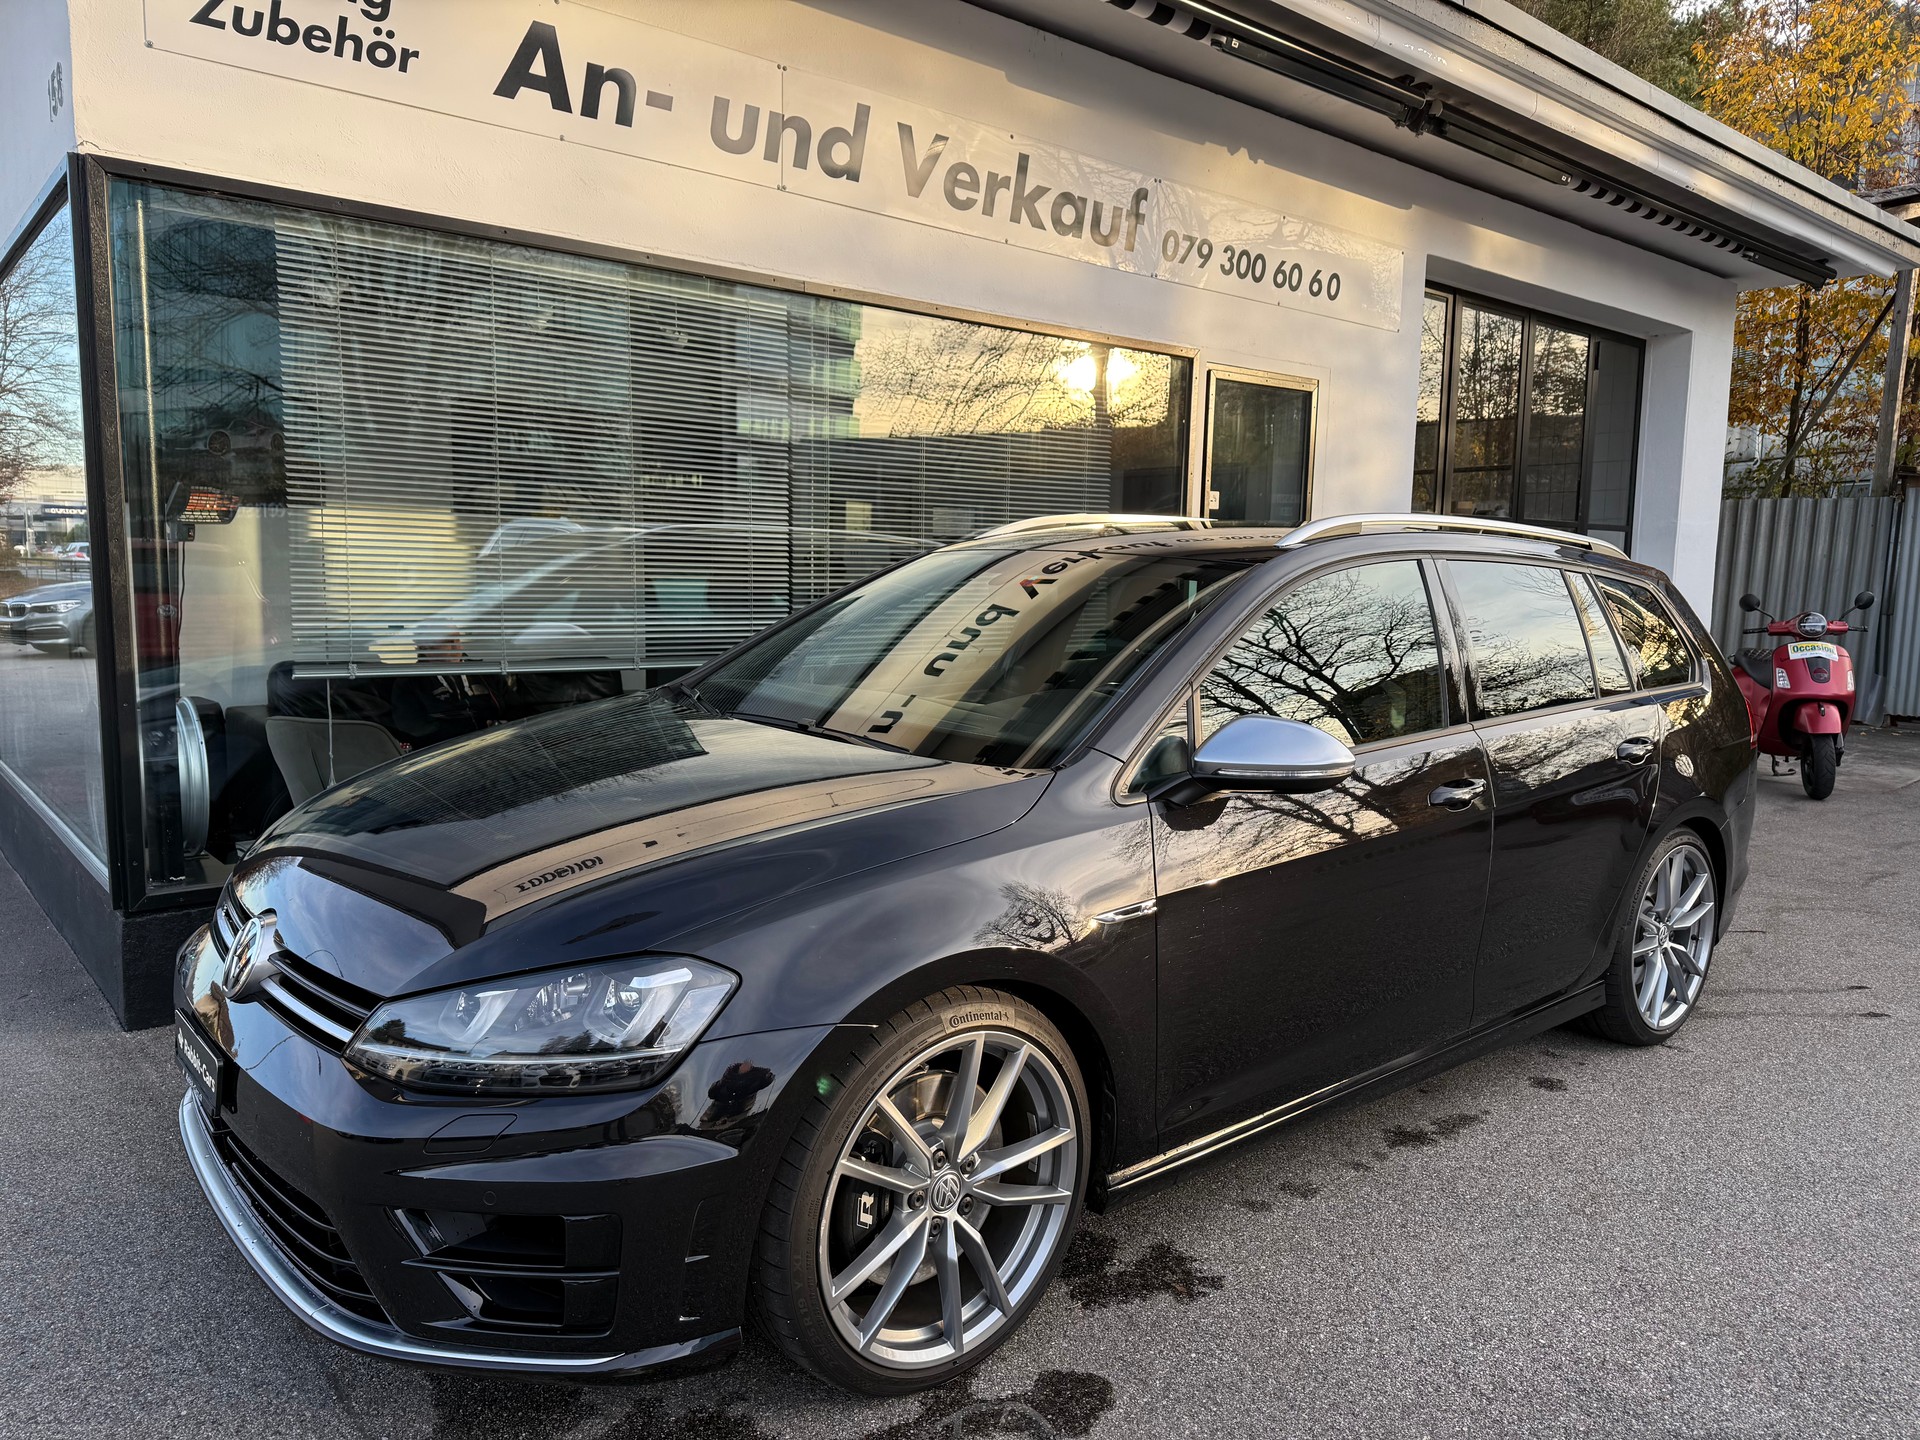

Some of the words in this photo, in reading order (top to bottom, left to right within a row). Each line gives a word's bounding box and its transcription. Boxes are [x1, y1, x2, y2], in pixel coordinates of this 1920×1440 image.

[189, 0, 420, 73] Zubehör
[493, 20, 674, 128] An-
[710, 95, 871, 183] und
[897, 121, 1149, 253] Verkauf
[1161, 229, 1213, 269] 079
[1220, 244, 1267, 283] 300
[1272, 260, 1303, 292] 60
[1308, 269, 1341, 301] 60
[948, 1011, 1002, 1028] Continental
[183, 1037, 216, 1093] Rabbit-Cars
